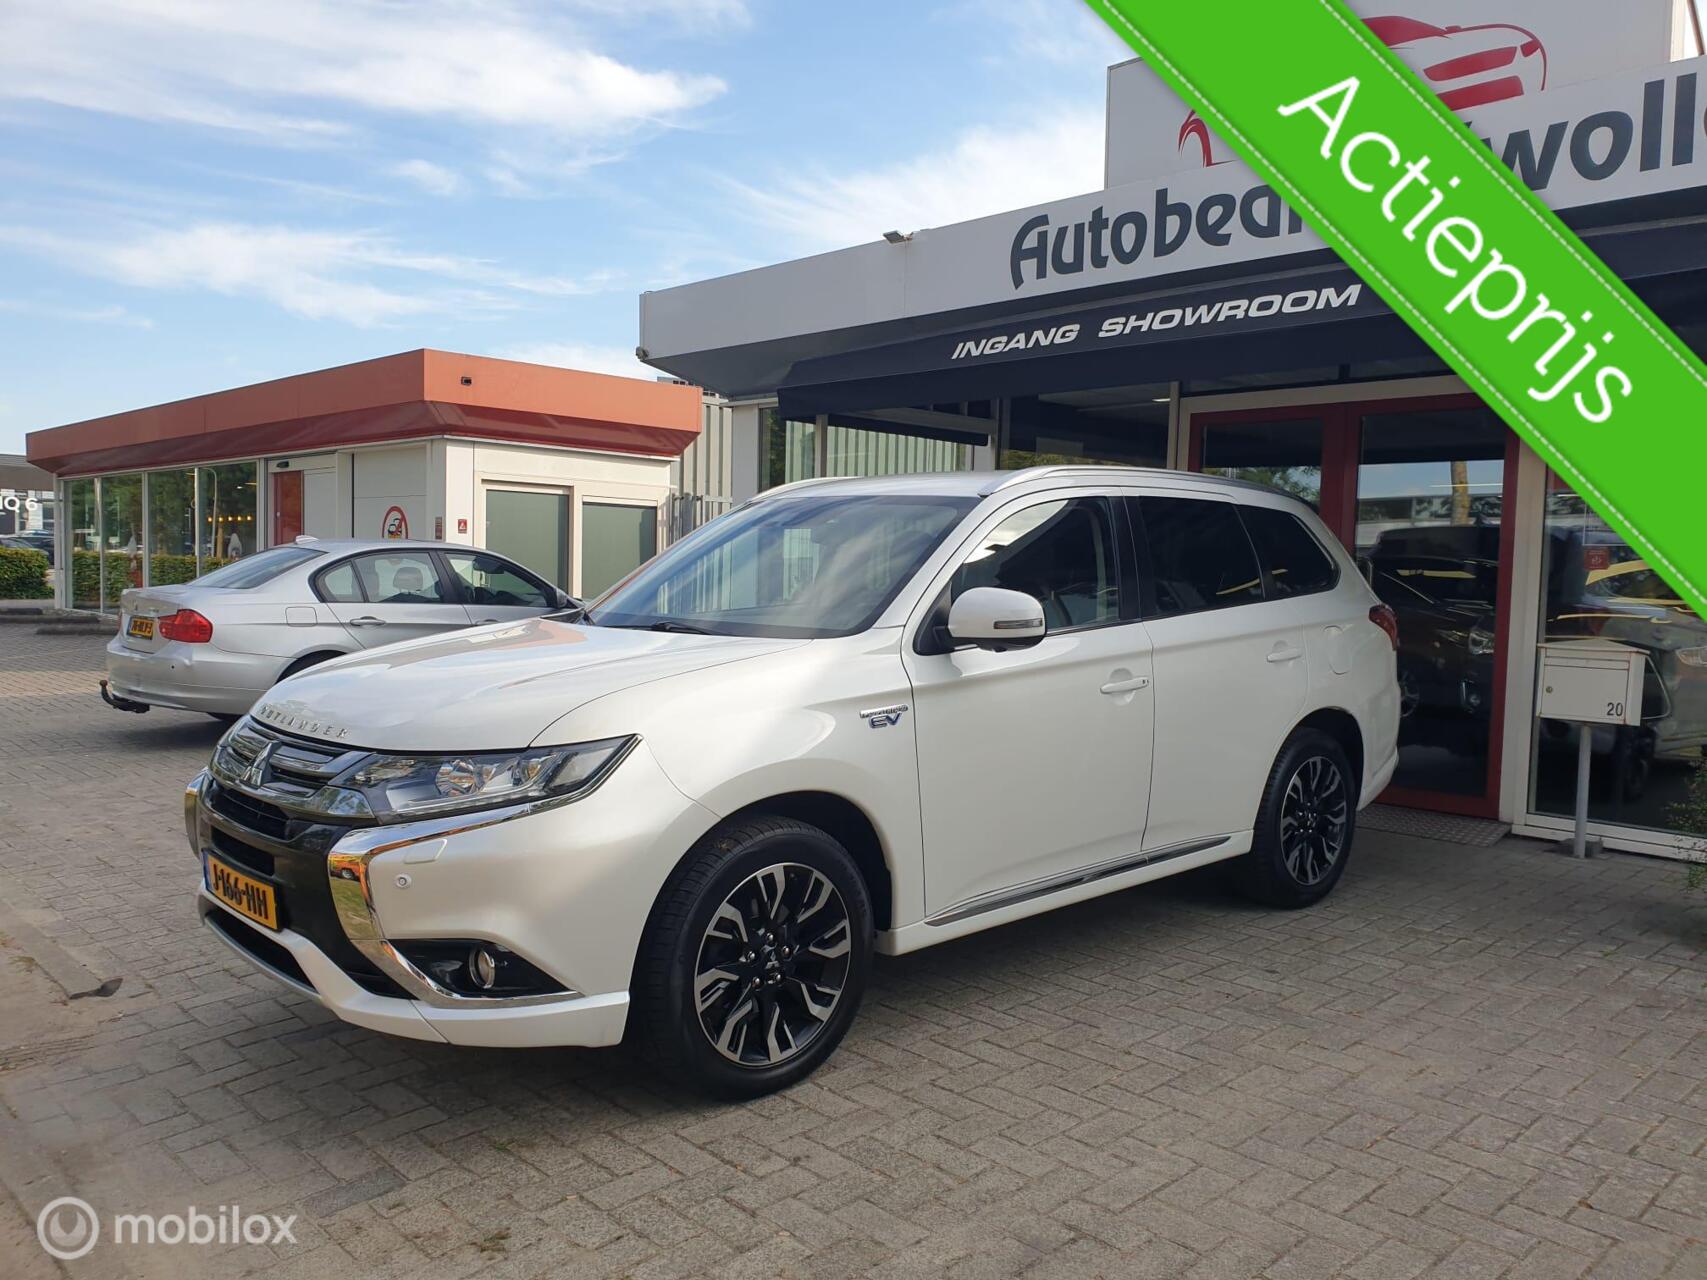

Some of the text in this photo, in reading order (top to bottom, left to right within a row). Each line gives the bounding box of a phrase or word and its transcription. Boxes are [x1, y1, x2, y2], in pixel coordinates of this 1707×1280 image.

[952, 285, 1362, 359] INGANG SHOWROOM
[868, 712, 903, 729] EV
[1606, 702, 1624, 717] 20
[213, 863, 269, 920] J-166-HH
